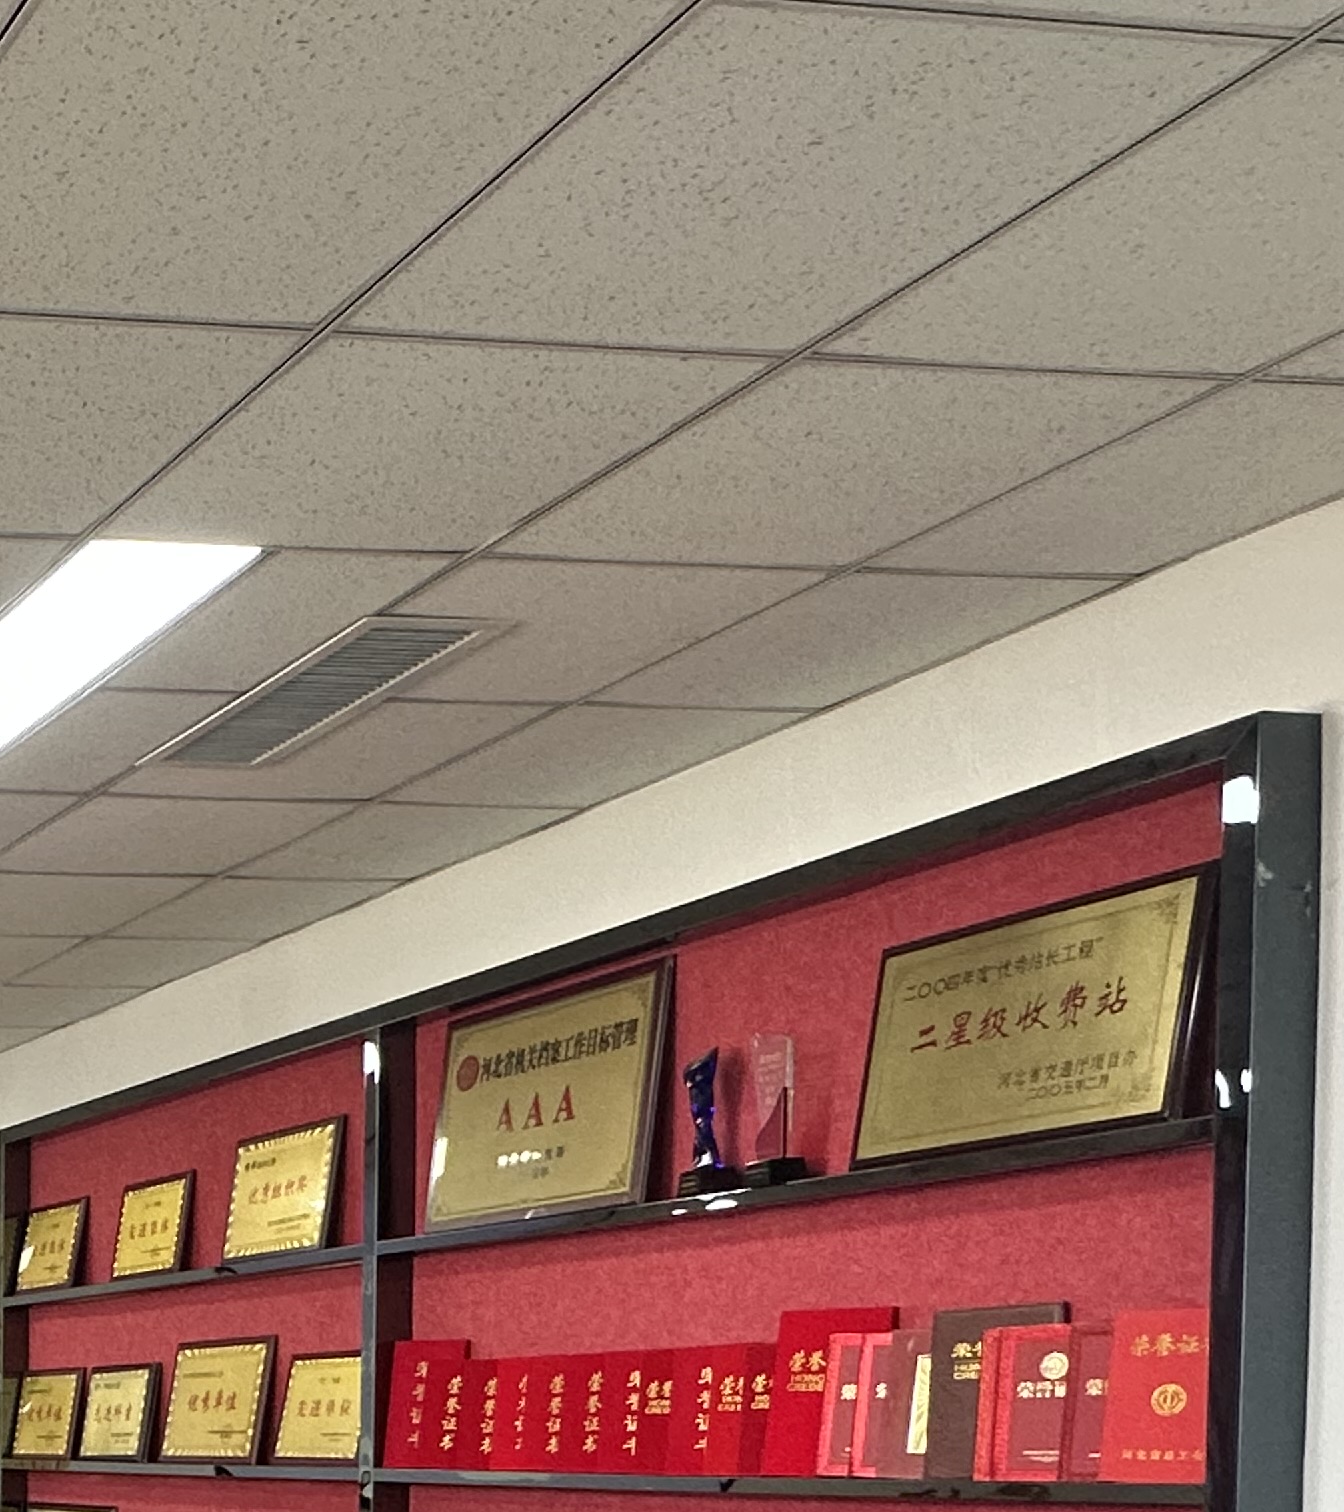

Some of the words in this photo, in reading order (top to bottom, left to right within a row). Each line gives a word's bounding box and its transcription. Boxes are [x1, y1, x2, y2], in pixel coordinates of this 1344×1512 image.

[910, 976, 1128, 1053] 二星级收费站
